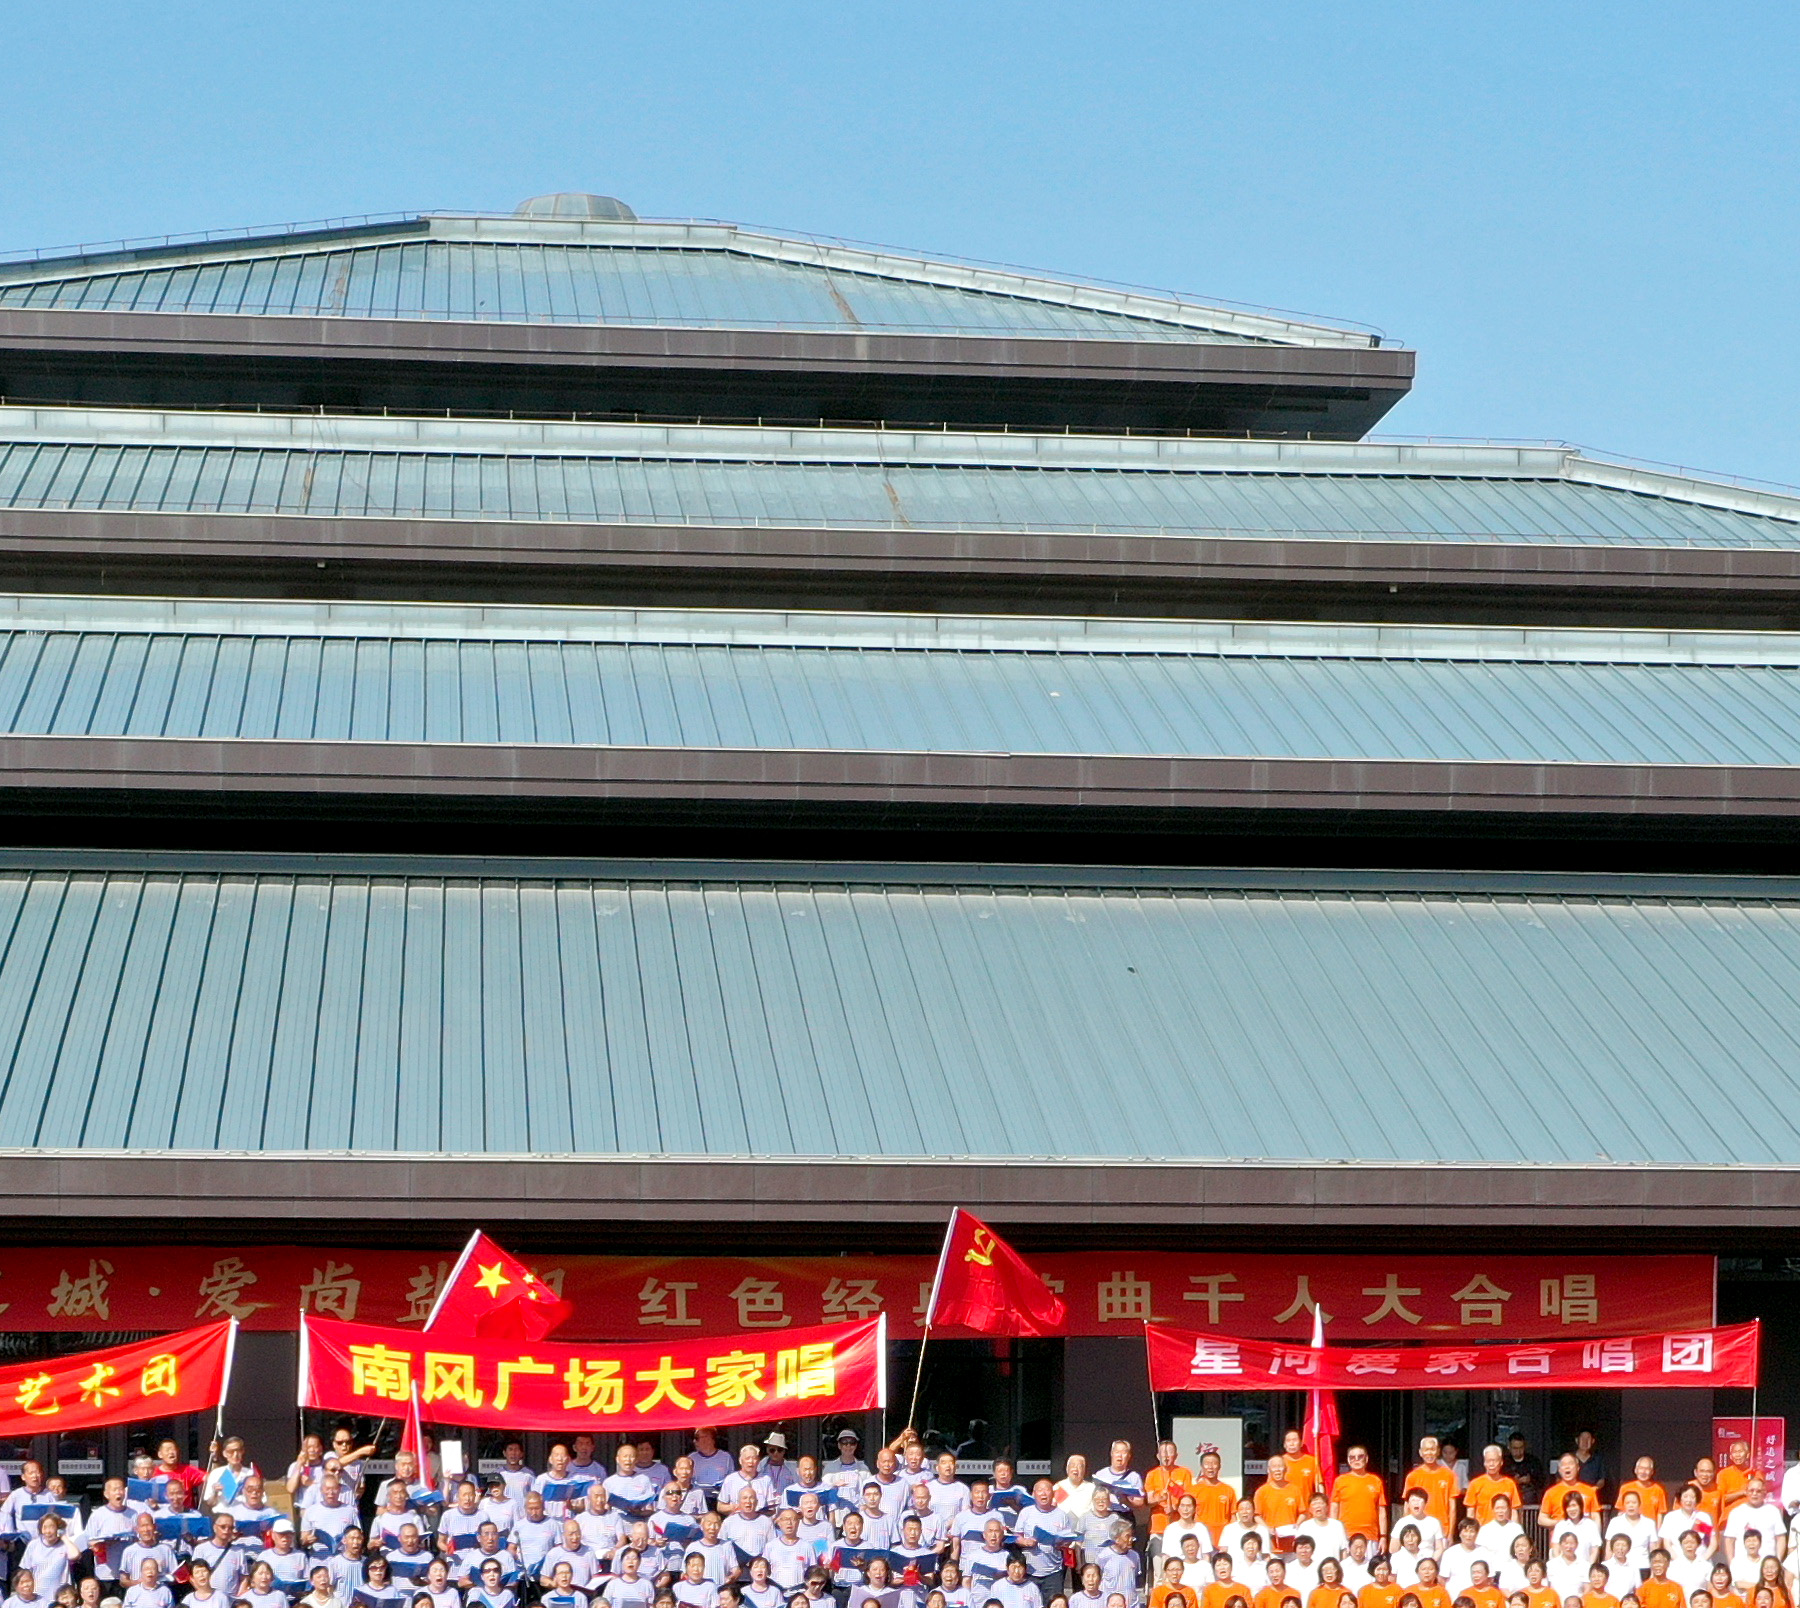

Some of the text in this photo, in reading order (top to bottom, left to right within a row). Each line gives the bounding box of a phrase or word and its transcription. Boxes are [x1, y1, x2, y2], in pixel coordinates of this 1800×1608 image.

[350, 1342, 838, 1415] 南风广场大家唱
